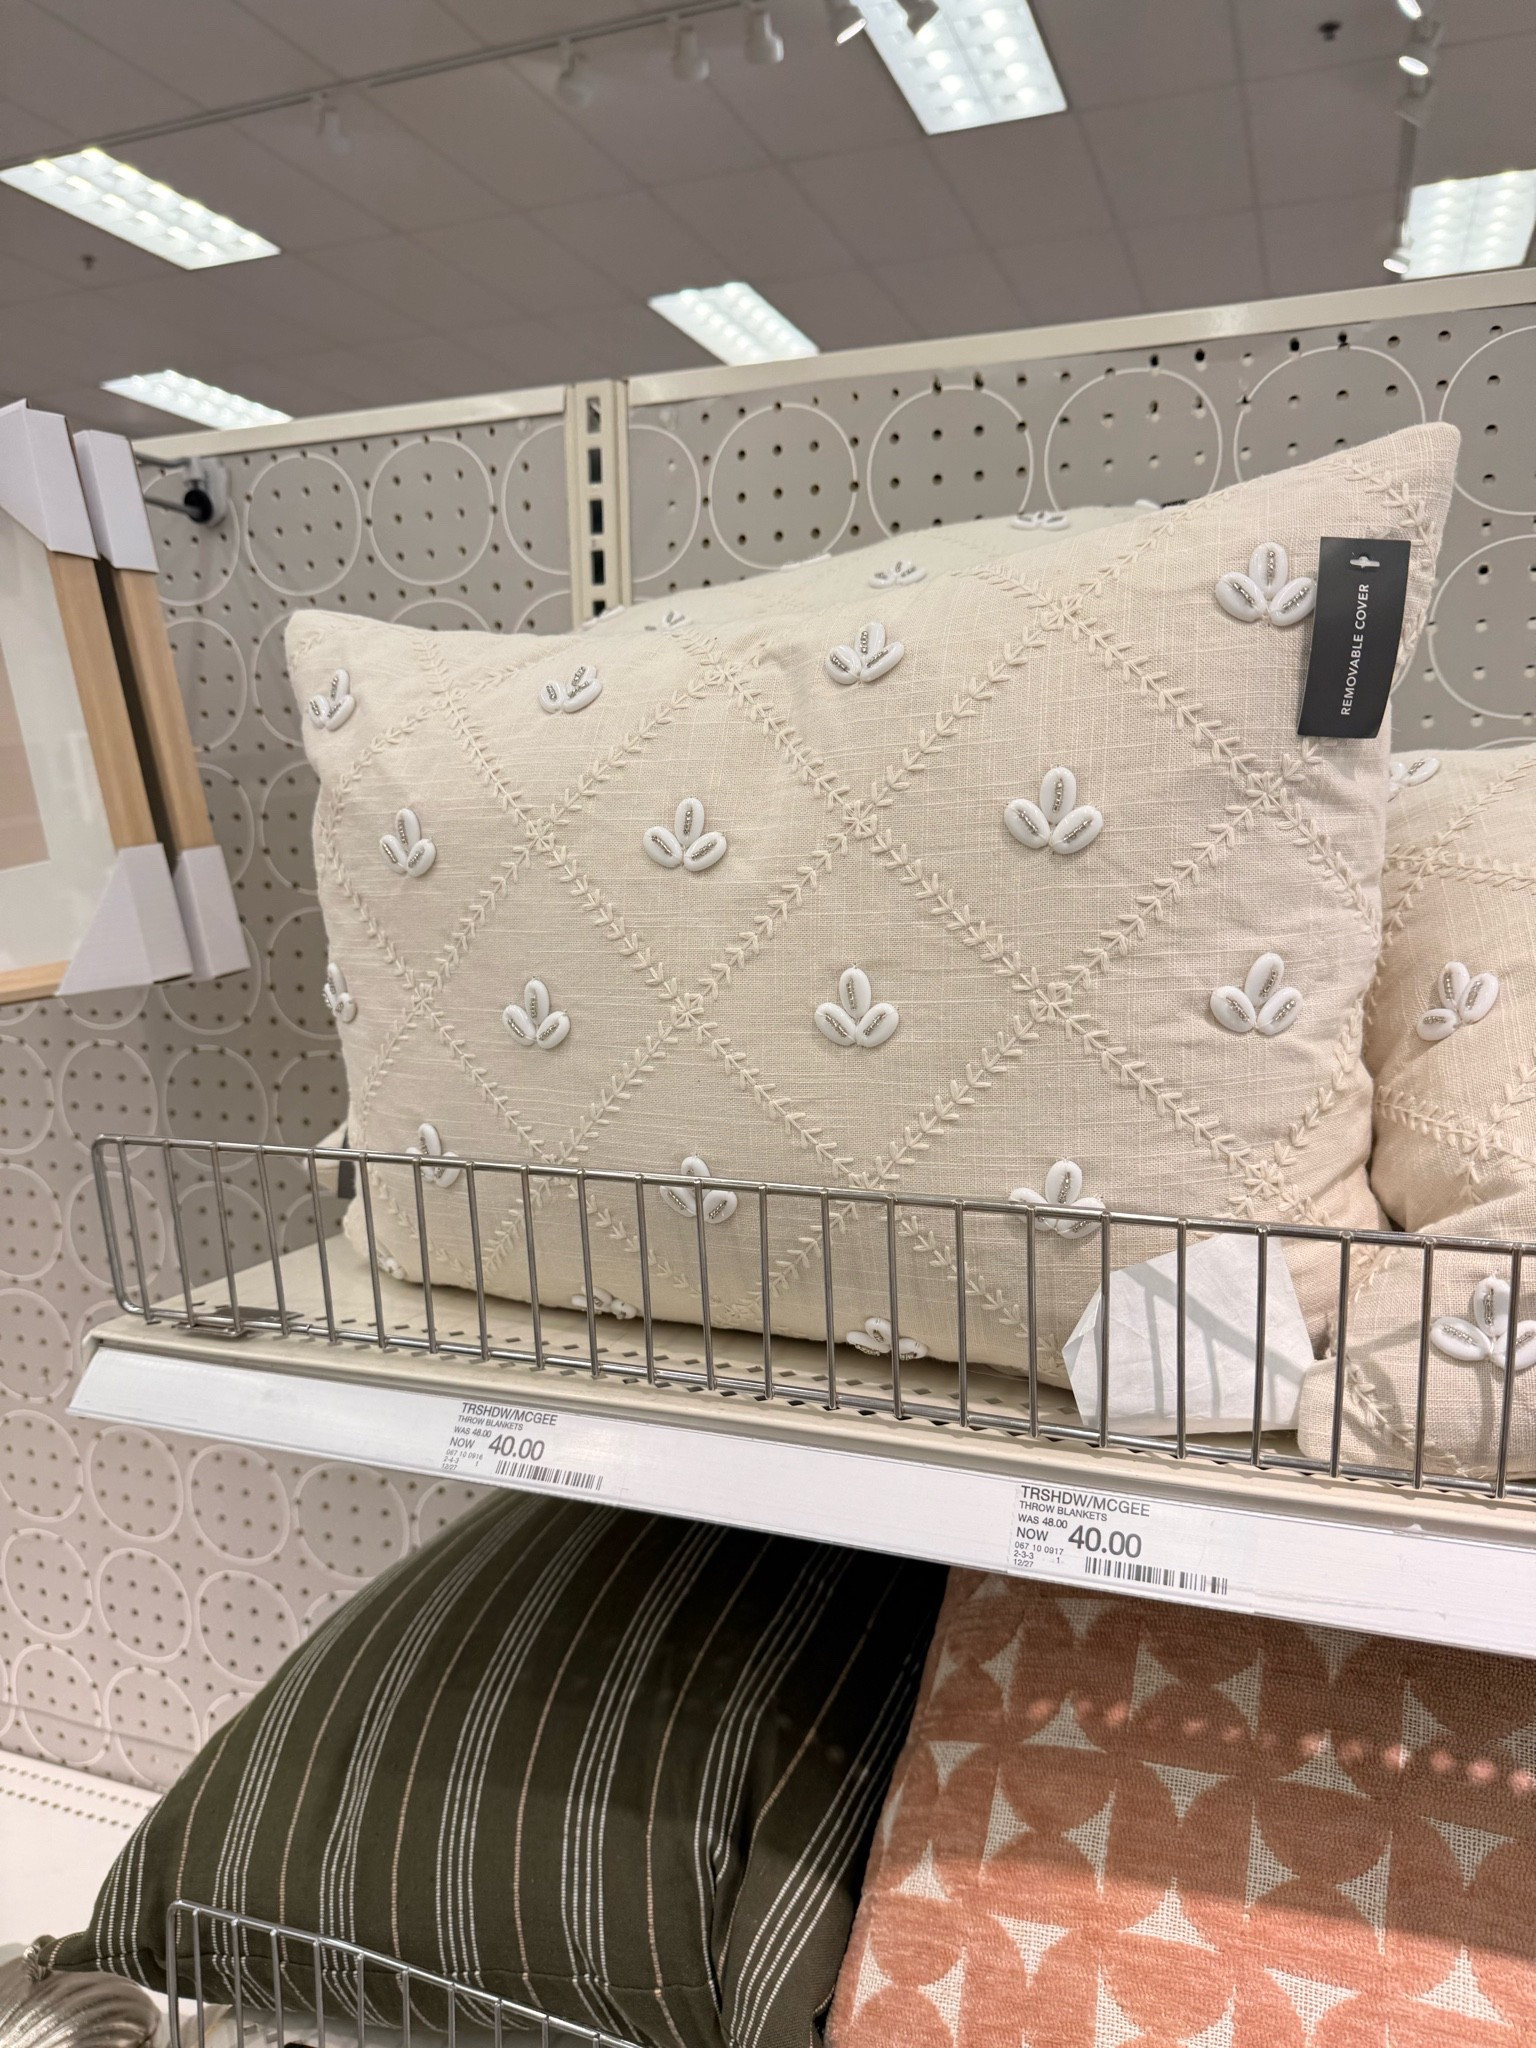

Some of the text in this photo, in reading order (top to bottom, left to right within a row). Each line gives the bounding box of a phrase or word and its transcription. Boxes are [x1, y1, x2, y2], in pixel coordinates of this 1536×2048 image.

[1341, 583, 1370, 716] REMOVABLE COVER
[461, 1402, 558, 1426] TRSHDW/MCGEE
[458, 1415, 523, 1431] THROW BLANKETS
[454, 1426, 492, 1438] WAS 48.00
[446, 1449, 458, 1457] 067
[459, 1450, 467, 1458] 10
[450, 1434, 545, 1461] NOW 40.00
[441, 1463, 458, 1471] 12/27
[443, 1456, 459, 1464] 2-4-3
[1021, 1485, 1151, 1517] TRSHDW/MCGEE
[1019, 1500, 1108, 1521] THROW BLANKETS
[1018, 1513, 1068, 1529] WAS 48.00
[1014, 1541, 1064, 1556] 067 10 0917
[1016, 1525, 1142, 1558] NOW 40.00
[1014, 1550, 1034, 1560] 2-3-3
[1013, 1559, 1034, 1568] 12/27
